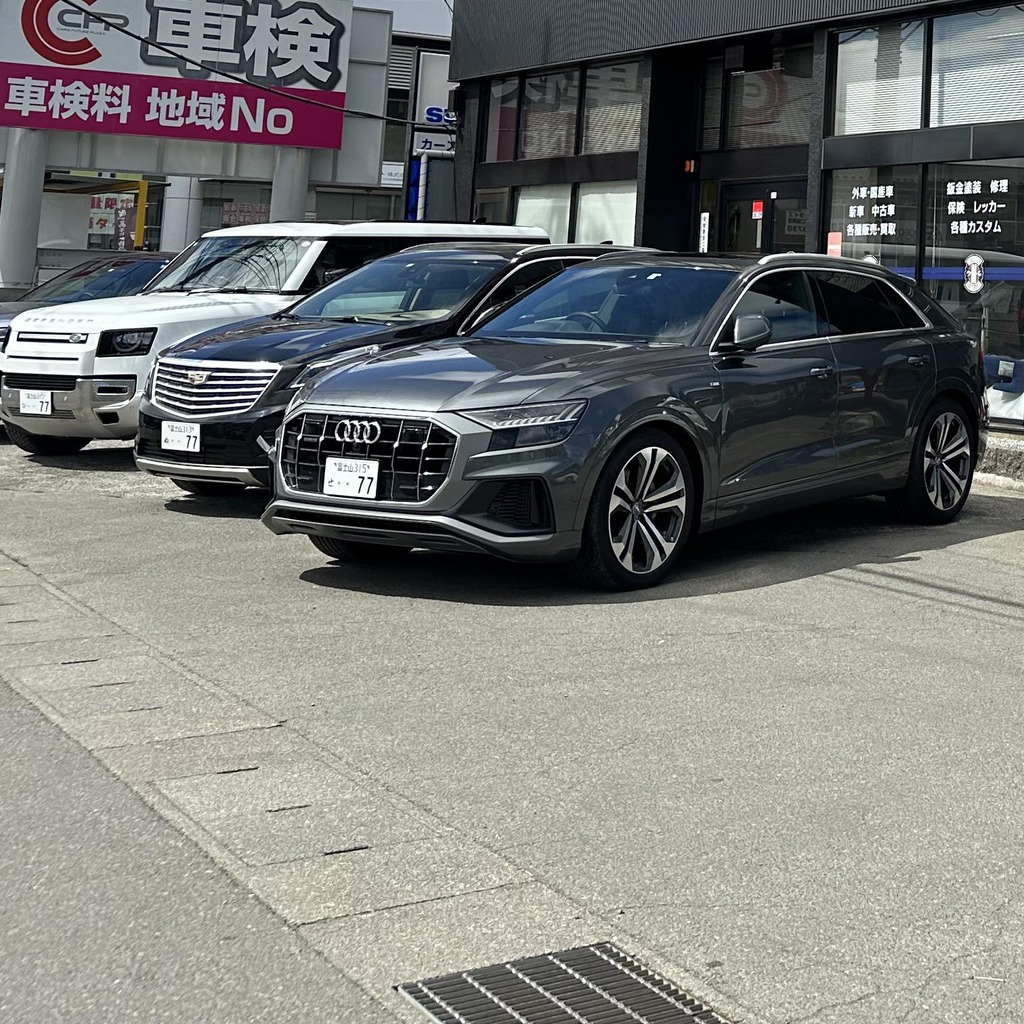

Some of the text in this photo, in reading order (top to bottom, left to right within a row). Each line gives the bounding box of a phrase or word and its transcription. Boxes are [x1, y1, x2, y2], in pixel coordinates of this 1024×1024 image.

[4, 76, 294, 136] 車検料 地域No
[989, 179, 1009, 194] 修理
[848, 204, 896, 218] 新車 中古車
[947, 199, 1007, 215] 保険 レッカー
[950, 220, 1002, 235] 各種カスタム
[186, 434, 198, 450] 77
[357, 475, 374, 495] 77
